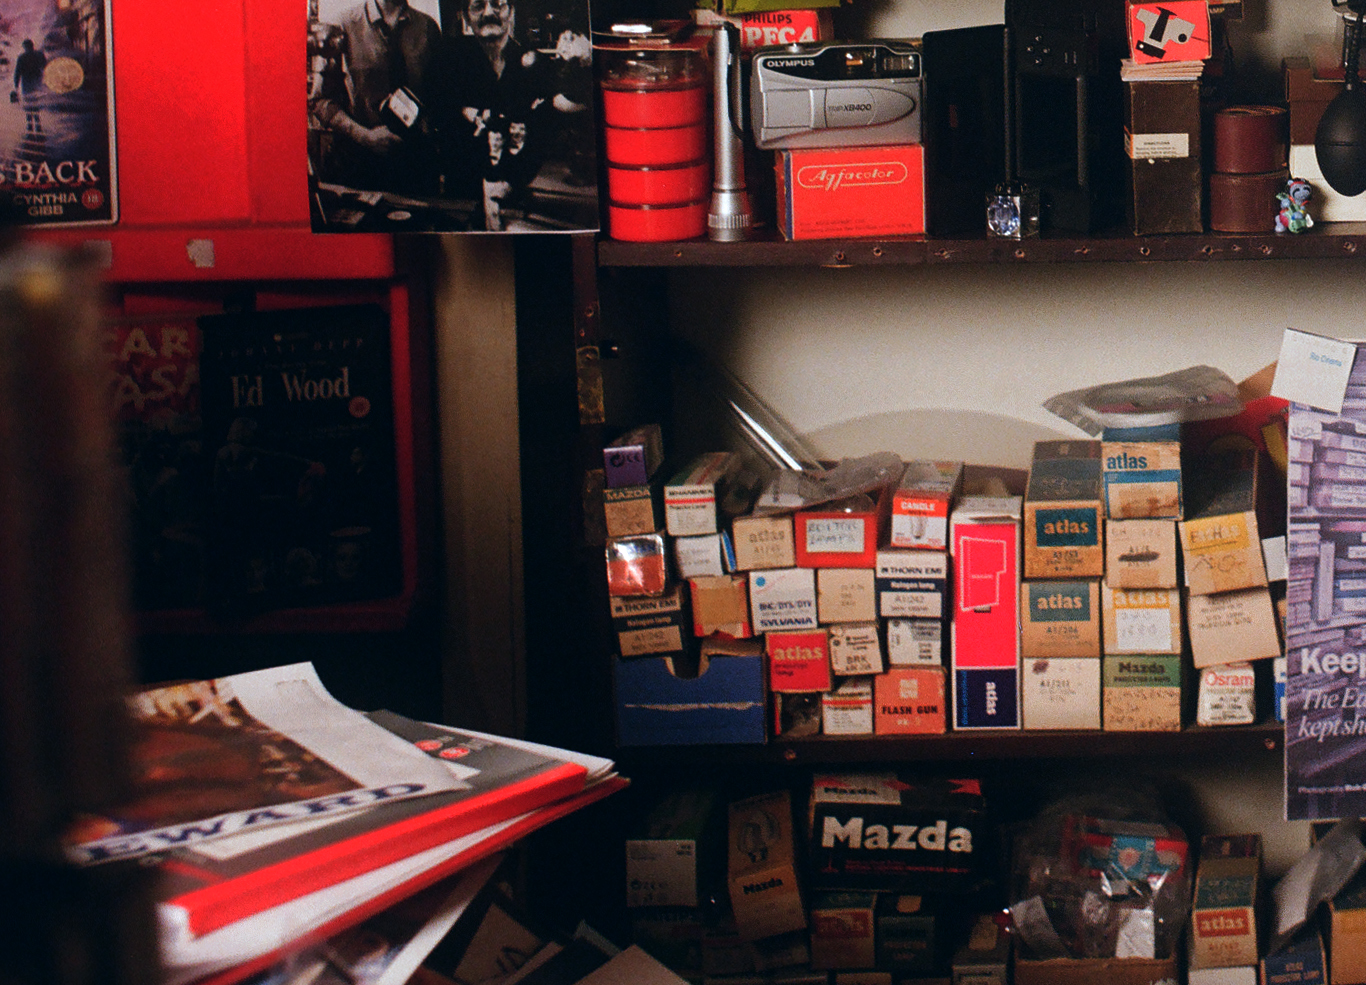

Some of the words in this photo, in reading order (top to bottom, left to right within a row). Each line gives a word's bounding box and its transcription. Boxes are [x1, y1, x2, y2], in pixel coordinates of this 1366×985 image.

[744, 14, 793, 26] PHILIPS
[766, 59, 815, 68] OLYMPUS
[15, 160, 99, 184] BACK
[808, 168, 895, 191] Agfacolor
[14, 192, 78, 205] CYNTHIA
[28, 205, 63, 217] GIBB
[230, 373, 264, 409] Ed
[281, 365, 350, 403] Wood
[1107, 451, 1149, 470] atlas
[603, 488, 651, 500] MAZDA
[901, 501, 935, 511] CANDLE
[1044, 519, 1090, 535] atlas
[750, 529, 785, 544] atlas
[890, 567, 920, 575] THORN
[922, 567, 942, 575] EMI
[624, 602, 657, 613] THORN
[657, 599, 678, 609] EMI
[1037, 593, 1083, 610] atlas
[760, 617, 813, 628] SYLVANIA
[774, 645, 824, 661] atlas
[1118, 661, 1166, 674] Mazda
[1205, 670, 1255, 687] Osram
[985, 681, 997, 716] atlas
[1301, 687, 1339, 710] The
[882, 705, 913, 715] FLASH
[916, 704, 939, 714] GUN
[1299, 715, 1341, 743] kept
[823, 786, 877, 795] Mazda
[821, 815, 974, 854] Mazda
[743, 878, 783, 894] Mazda
[1200, 916, 1246, 931] atlas
